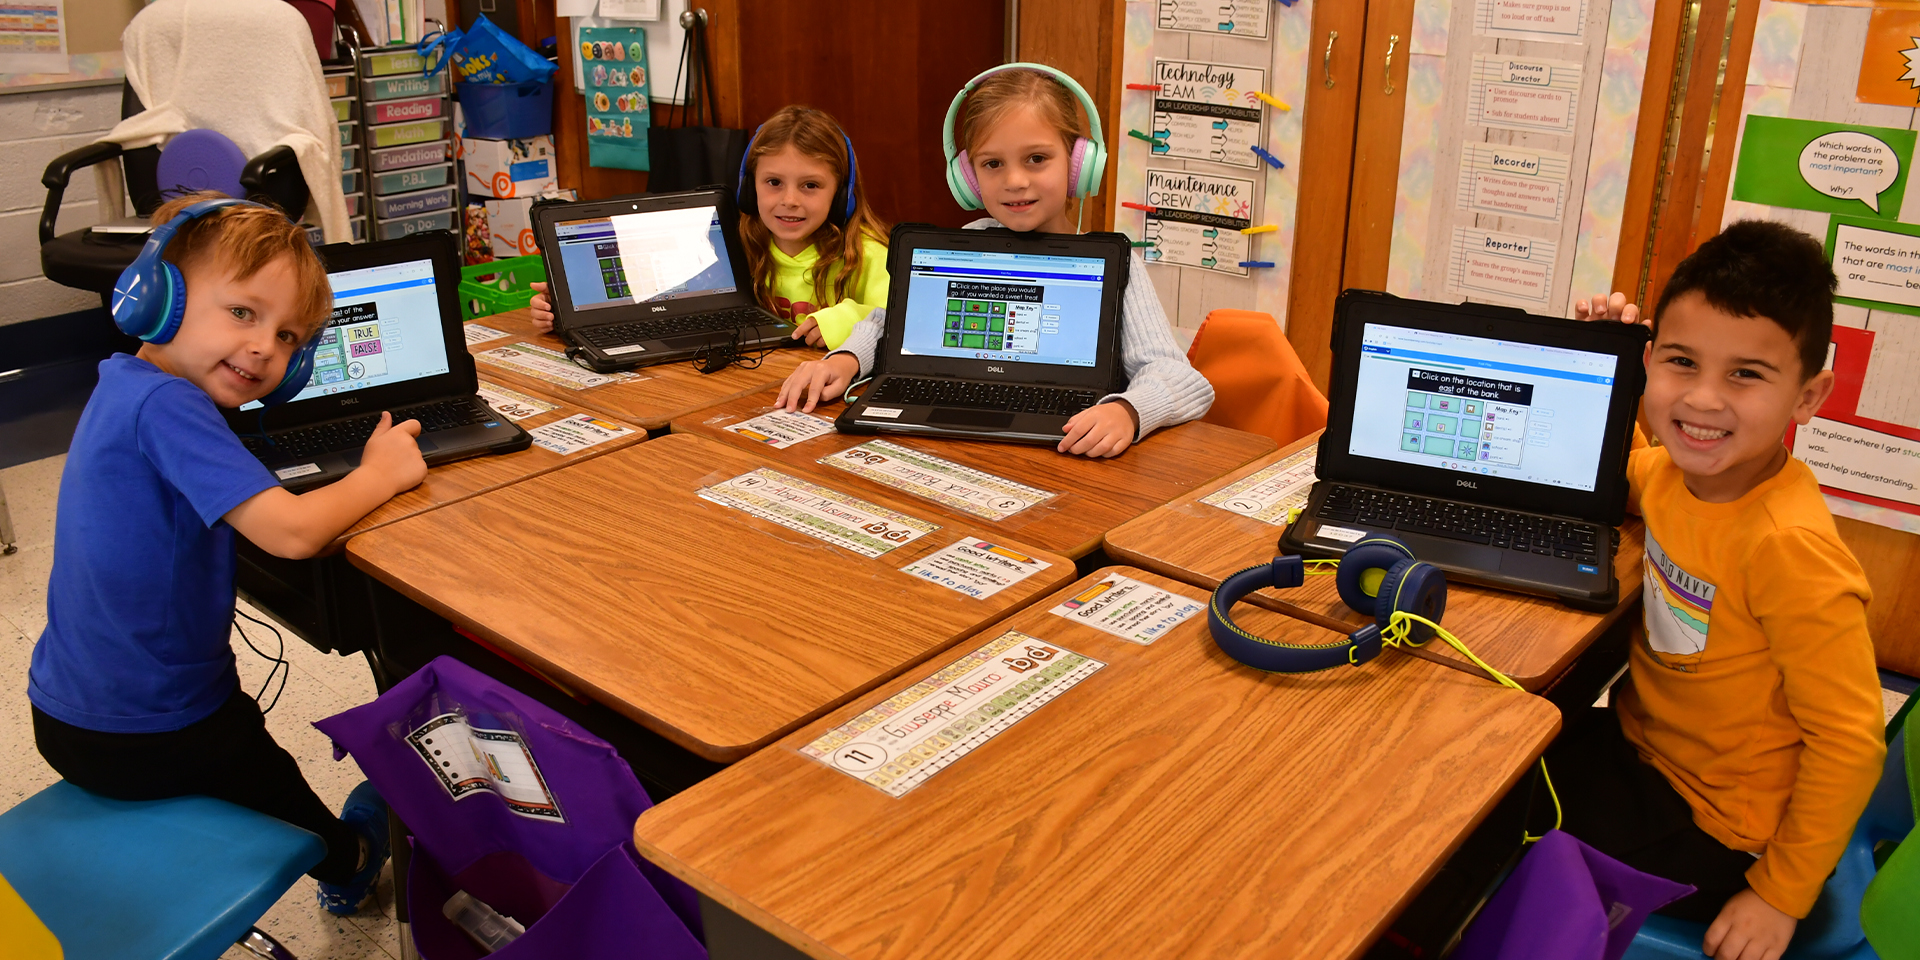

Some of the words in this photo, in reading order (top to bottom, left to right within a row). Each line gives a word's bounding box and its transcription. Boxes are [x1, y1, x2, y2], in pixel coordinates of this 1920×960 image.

[1536, 4, 1553, 12] group
[391, 56, 419, 69] Tests
[1509, 61, 1543, 72] Discourse
[1157, 63, 1235, 89] Technology
[1511, 73, 1540, 83] Director
[387, 80, 429, 93] Writing
[1493, 96, 1518, 104] promote
[1508, 89, 1536, 98] discourse
[1538, 92, 1554, 100] cards
[386, 104, 433, 117] Reading
[1174, 103, 1209, 112] LEADERSHIP
[1211, 107, 1259, 118] RESPONSIBILITIES
[1504, 110, 1512, 118] for
[1514, 112, 1539, 120] students
[1540, 115, 1560, 123] absent
[394, 126, 424, 140] Math
[1819, 140, 1844, 150] Which
[1846, 143, 1871, 154] words
[1873, 146, 1882, 154] in
[381, 147, 443, 165] Fundations
[1494, 155, 1536, 169] Recorder
[1814, 151, 1827, 160] the
[1829, 152, 1866, 165] problem
[1868, 158, 1883, 166] are
[1810, 162, 1832, 171] most
[1833, 164, 1883, 177] important?
[1150, 172, 1239, 197] Maintenance
[1483, 176, 1500, 185] Writes
[1502, 178, 1517, 187] down
[1519, 181, 1527, 189] the
[1529, 182, 1550, 192] group's
[1830, 185, 1853, 195] Why?
[1149, 192, 1192, 208] CREW
[1482, 188, 1505, 198] thoughts
[1506, 191, 1517, 199] and
[1518, 194, 1541, 202] answers
[1542, 196, 1555, 204] with
[389, 198, 423, 213] Morning
[426, 194, 447, 206] Work
[1494, 200, 1528, 212] handwriting
[403, 222, 414, 233] To
[418, 220, 436, 231] Do:
[1165, 211, 1200, 220] LEADERSHIP
[1202, 215, 1249, 228] RESPONSIBILITIES
[1486, 237, 1528, 252] Reporter
[1845, 241, 1862, 251] The
[1865, 247, 1896, 256] words
[1898, 249, 1907, 257] in
[1472, 259, 1490, 269] Shares
[1491, 262, 1499, 270] the
[1501, 264, 1521, 274] group's
[1522, 268, 1544, 277] answers
[1842, 256, 1864, 265] that
[1866, 261, 1883, 269] are
[1886, 264, 1913, 273] most
[1471, 270, 1483, 278] from
[1494, 274, 1522, 285] recorder's
[1523, 279, 1537, 288] notes
[1849, 273, 1866, 281] are
[991, 285, 1006, 293] place
[338, 317, 350, 325] your
[354, 327, 373, 340] TRUE
[354, 342, 378, 355] FALSE
[1421, 371, 1439, 382] Click
[1440, 375, 1450, 383] on
[1466, 378, 1496, 390] location
[1497, 383, 1512, 391] that
[1515, 385, 1521, 393] is
[1438, 385, 1454, 394] east
[1456, 386, 1465, 394] of
[1467, 388, 1479, 396] the
[1495, 406, 1507, 414] Map
[1812, 427, 1827, 437] The
[1828, 431, 1852, 442] place
[1854, 438, 1879, 449] where
[1885, 446, 1901, 454] got
[1809, 459, 1829, 469] need
[1831, 462, 1849, 474] help
[739, 478, 759, 486] 14
[1456, 479, 1478, 490] DELL
[773, 486, 813, 506] Abigail
[813, 499, 866, 524] Musumeci
[1234, 501, 1253, 510] 2
[957, 546, 982, 558] Good
[918, 569, 940, 580] like
[941, 575, 955, 586] to
[1660, 553, 1674, 578] OLD
[1676, 570, 1709, 598] NAVY
[1078, 601, 1103, 618] Good
[1135, 633, 1148, 641] I
[1142, 622, 1165, 636] like
[1162, 616, 1177, 625] to
[882, 700, 957, 738] Giuseppe
[946, 672, 1002, 700] Mauro
[844, 749, 874, 764] 11
